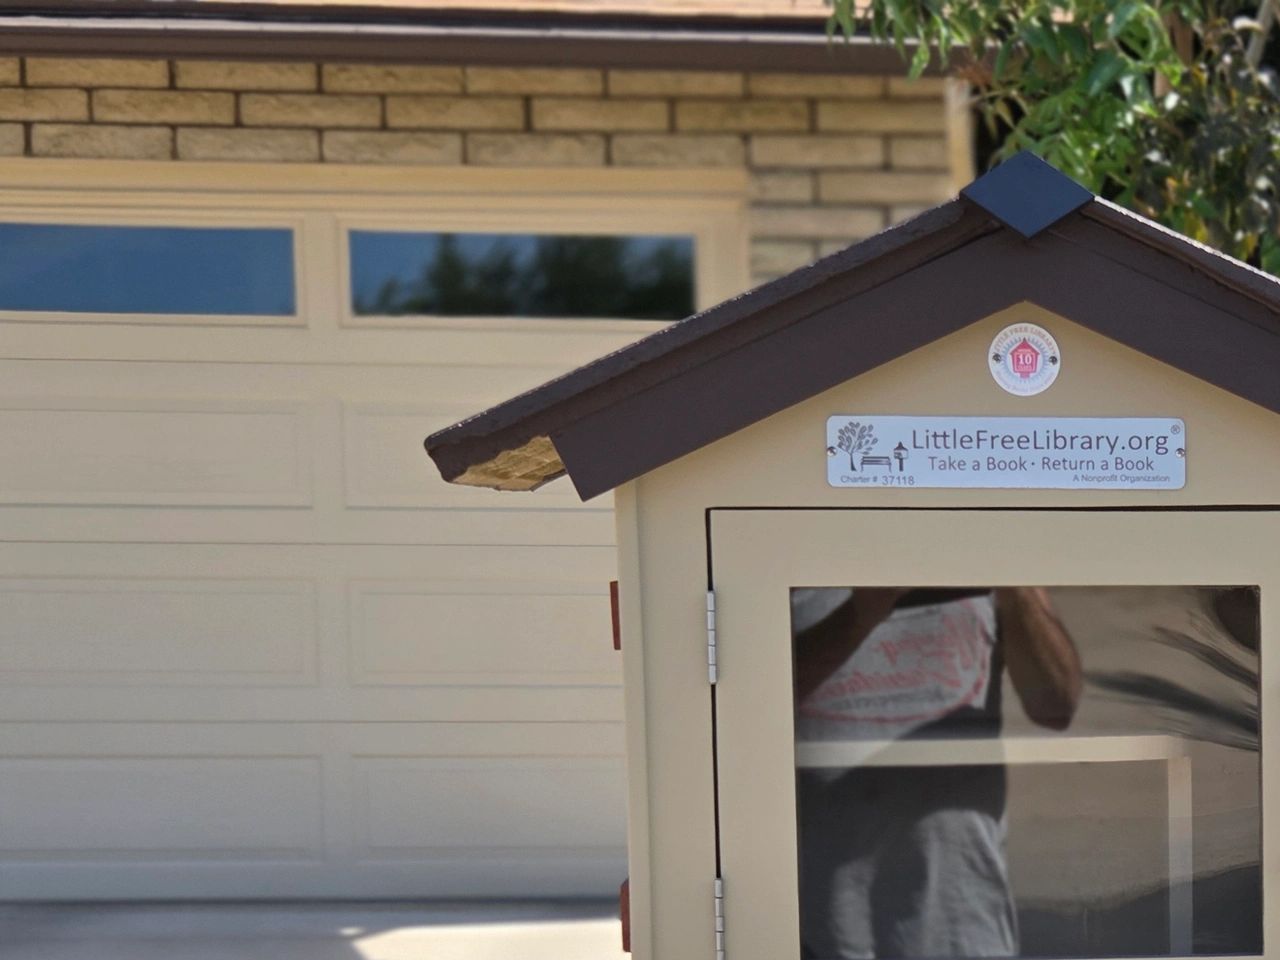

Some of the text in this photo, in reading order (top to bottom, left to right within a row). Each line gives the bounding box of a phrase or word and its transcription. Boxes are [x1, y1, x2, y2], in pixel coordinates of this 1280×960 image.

[1018, 353, 1032, 365] 10
[912, 428, 1169, 456] LittleFreeLibrary.org
[928, 456, 1154, 471] Take a Book Return a Book
[840, 475, 870, 484] Charter
[881, 475, 915, 486] 37118
[1073, 474, 1170, 483] A Nonprofit Organization
